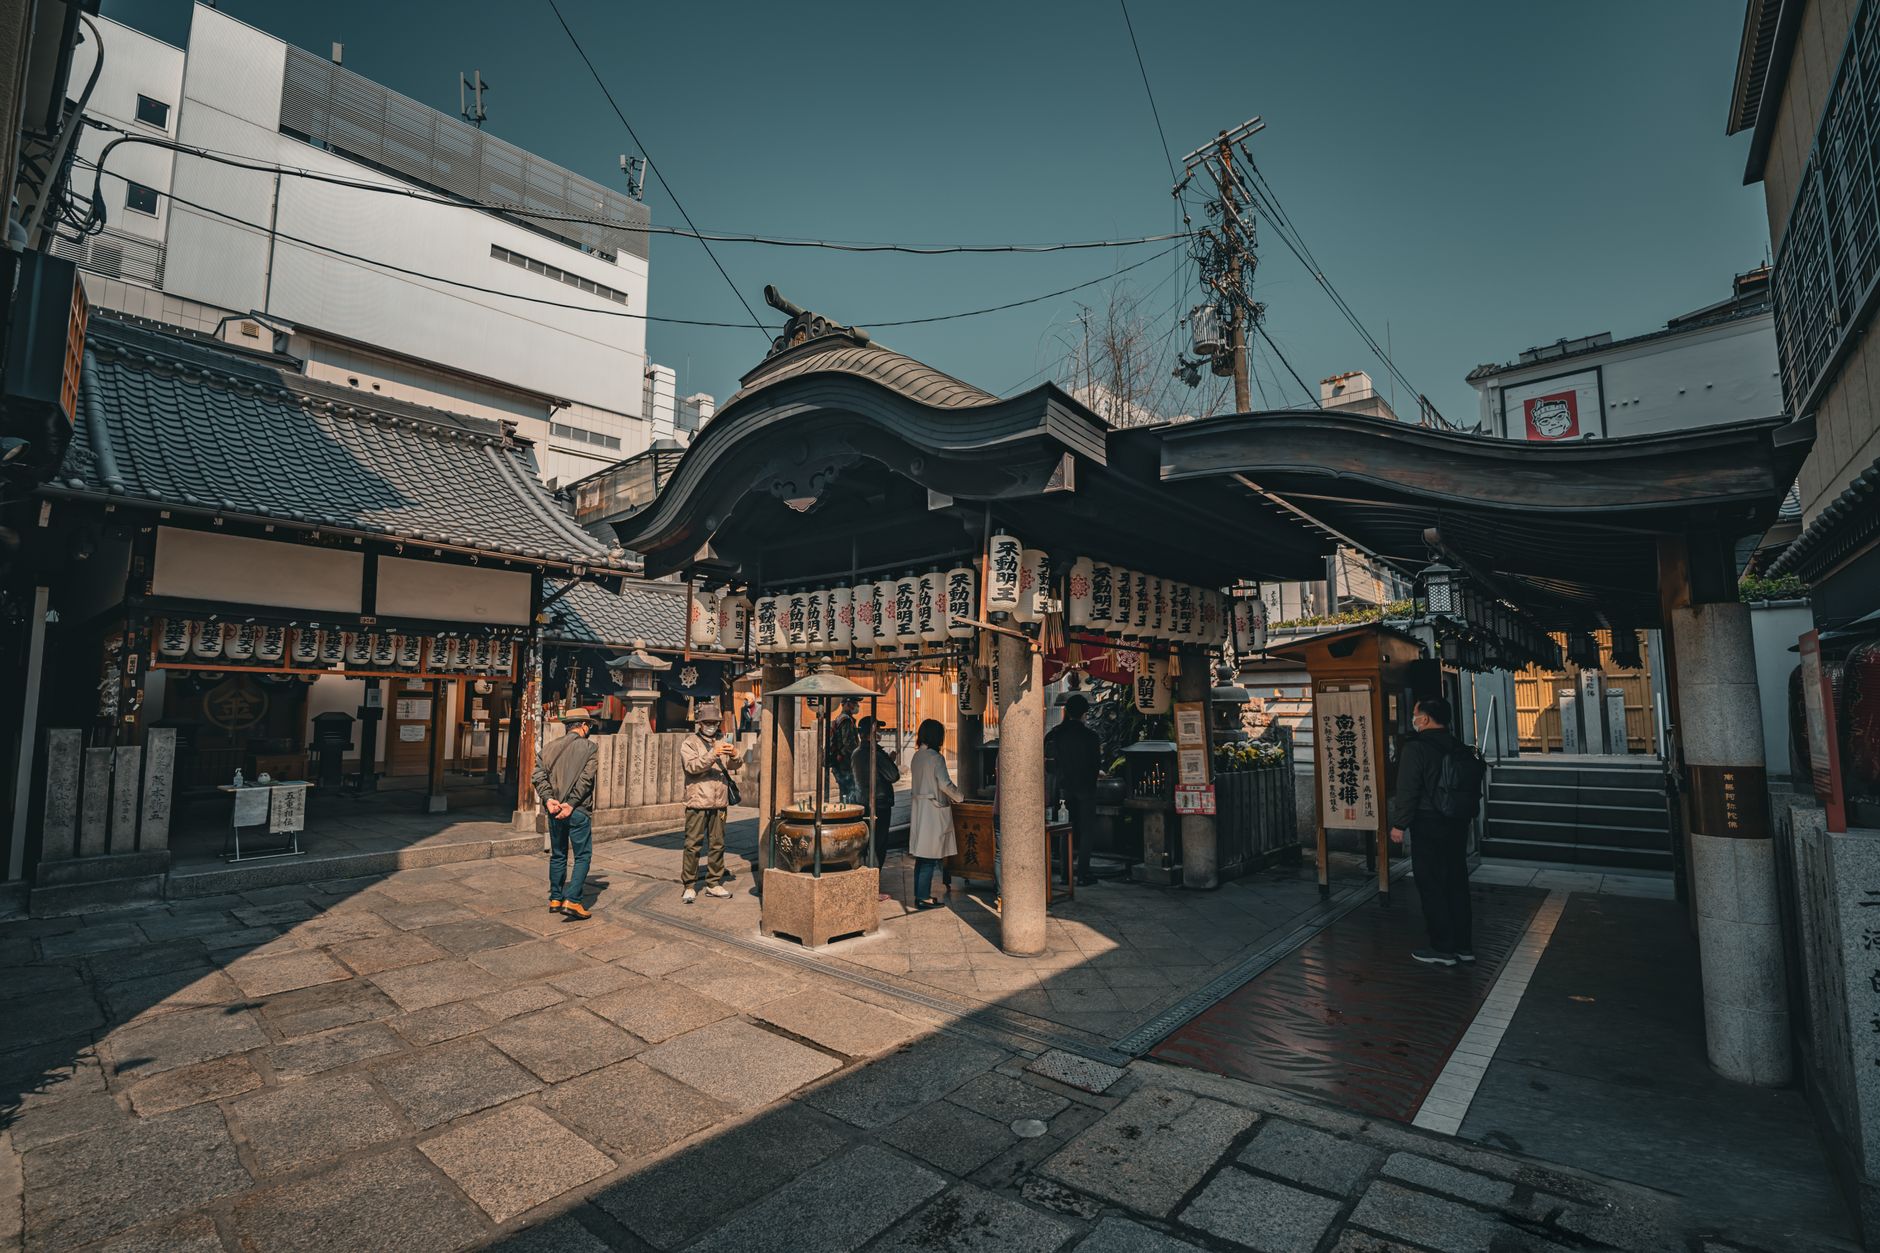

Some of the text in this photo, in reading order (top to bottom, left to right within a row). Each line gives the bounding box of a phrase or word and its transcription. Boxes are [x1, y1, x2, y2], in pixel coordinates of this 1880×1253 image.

[992, 541, 1020, 603] 不動明王
[1092, 567, 1112, 620] 不動明王
[706, 596, 716, 635] 山本大河
[757, 600, 778, 646] 不動明王
[896, 583, 915, 636] 不動明王
[948, 573, 972, 630] 不動明王
